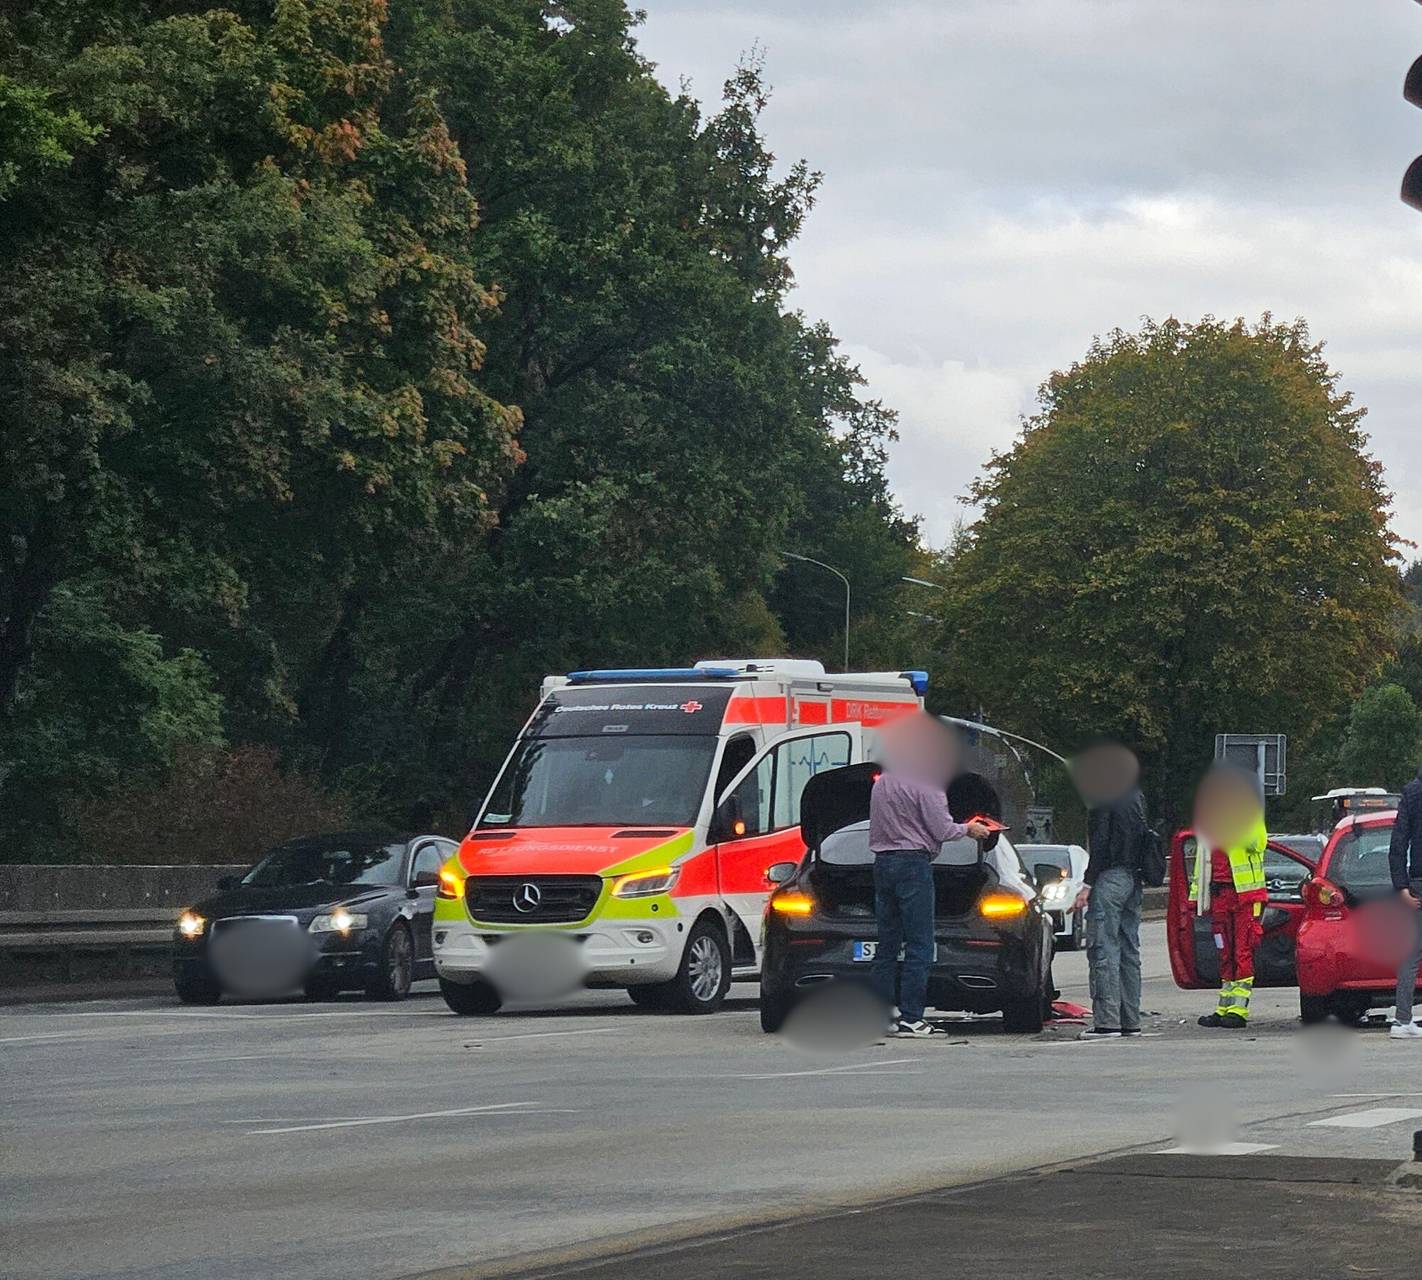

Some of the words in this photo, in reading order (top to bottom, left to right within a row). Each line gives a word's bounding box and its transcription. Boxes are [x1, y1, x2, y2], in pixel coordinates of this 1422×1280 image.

[554, 704, 609, 713] Deutsches
[610, 703, 643, 711] Rotes
[644, 703, 678, 711] Kreuz
